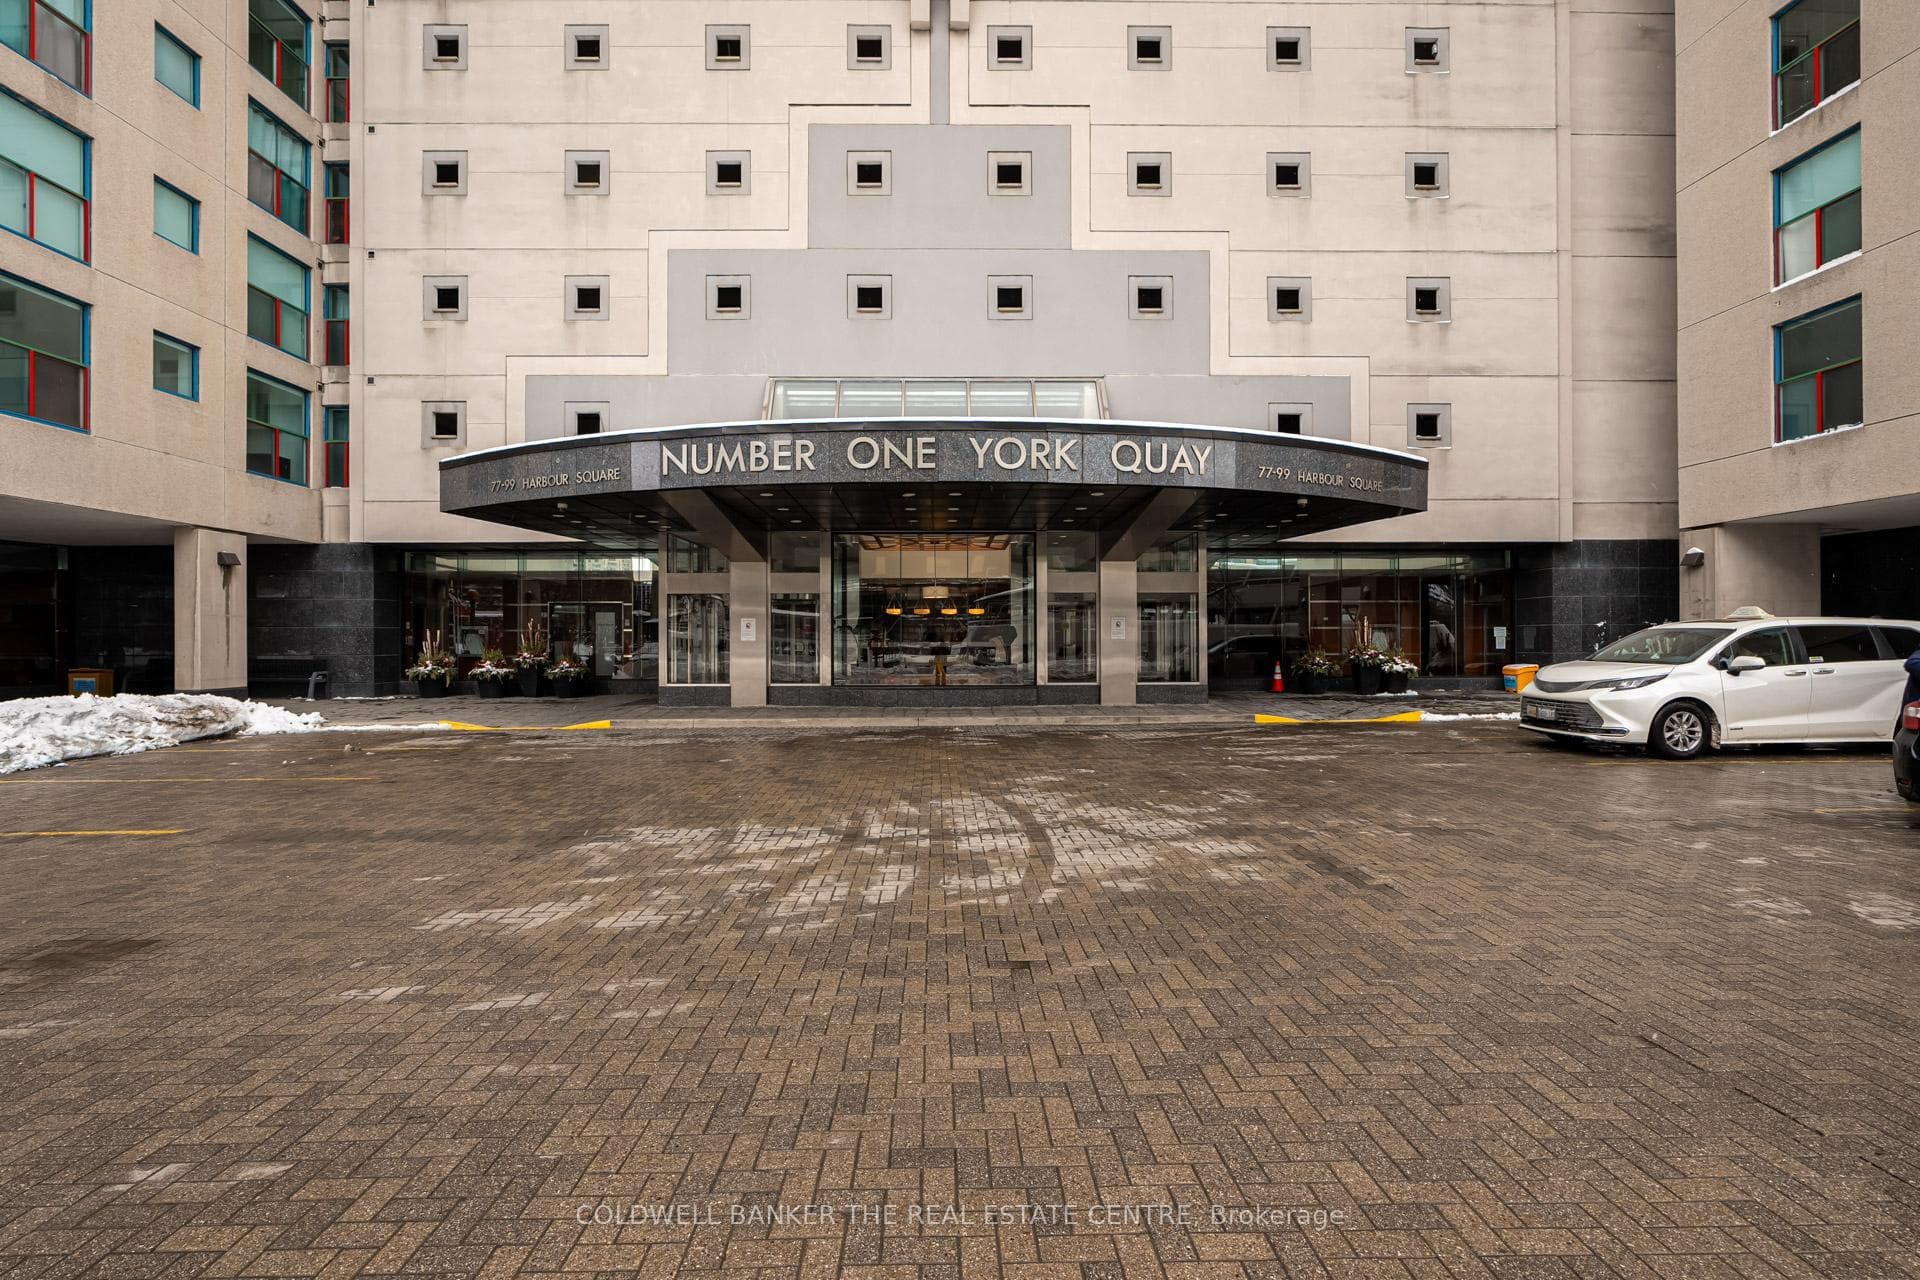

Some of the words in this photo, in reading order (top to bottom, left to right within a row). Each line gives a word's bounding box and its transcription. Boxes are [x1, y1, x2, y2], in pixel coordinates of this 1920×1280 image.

[661, 438, 817, 477] NUMBER
[846, 436, 937, 470] ONE
[968, 437, 1079, 471] YORK
[1110, 439, 1212, 475] QUAY
[490, 479, 516, 493] 77-99
[521, 473, 569, 490] HARBOUR
[576, 467, 621, 485] SQUARE
[1258, 466, 1291, 480] 77-99
[1297, 471, 1345, 488] HARBOUR
[1349, 476, 1383, 493] SQUARE
